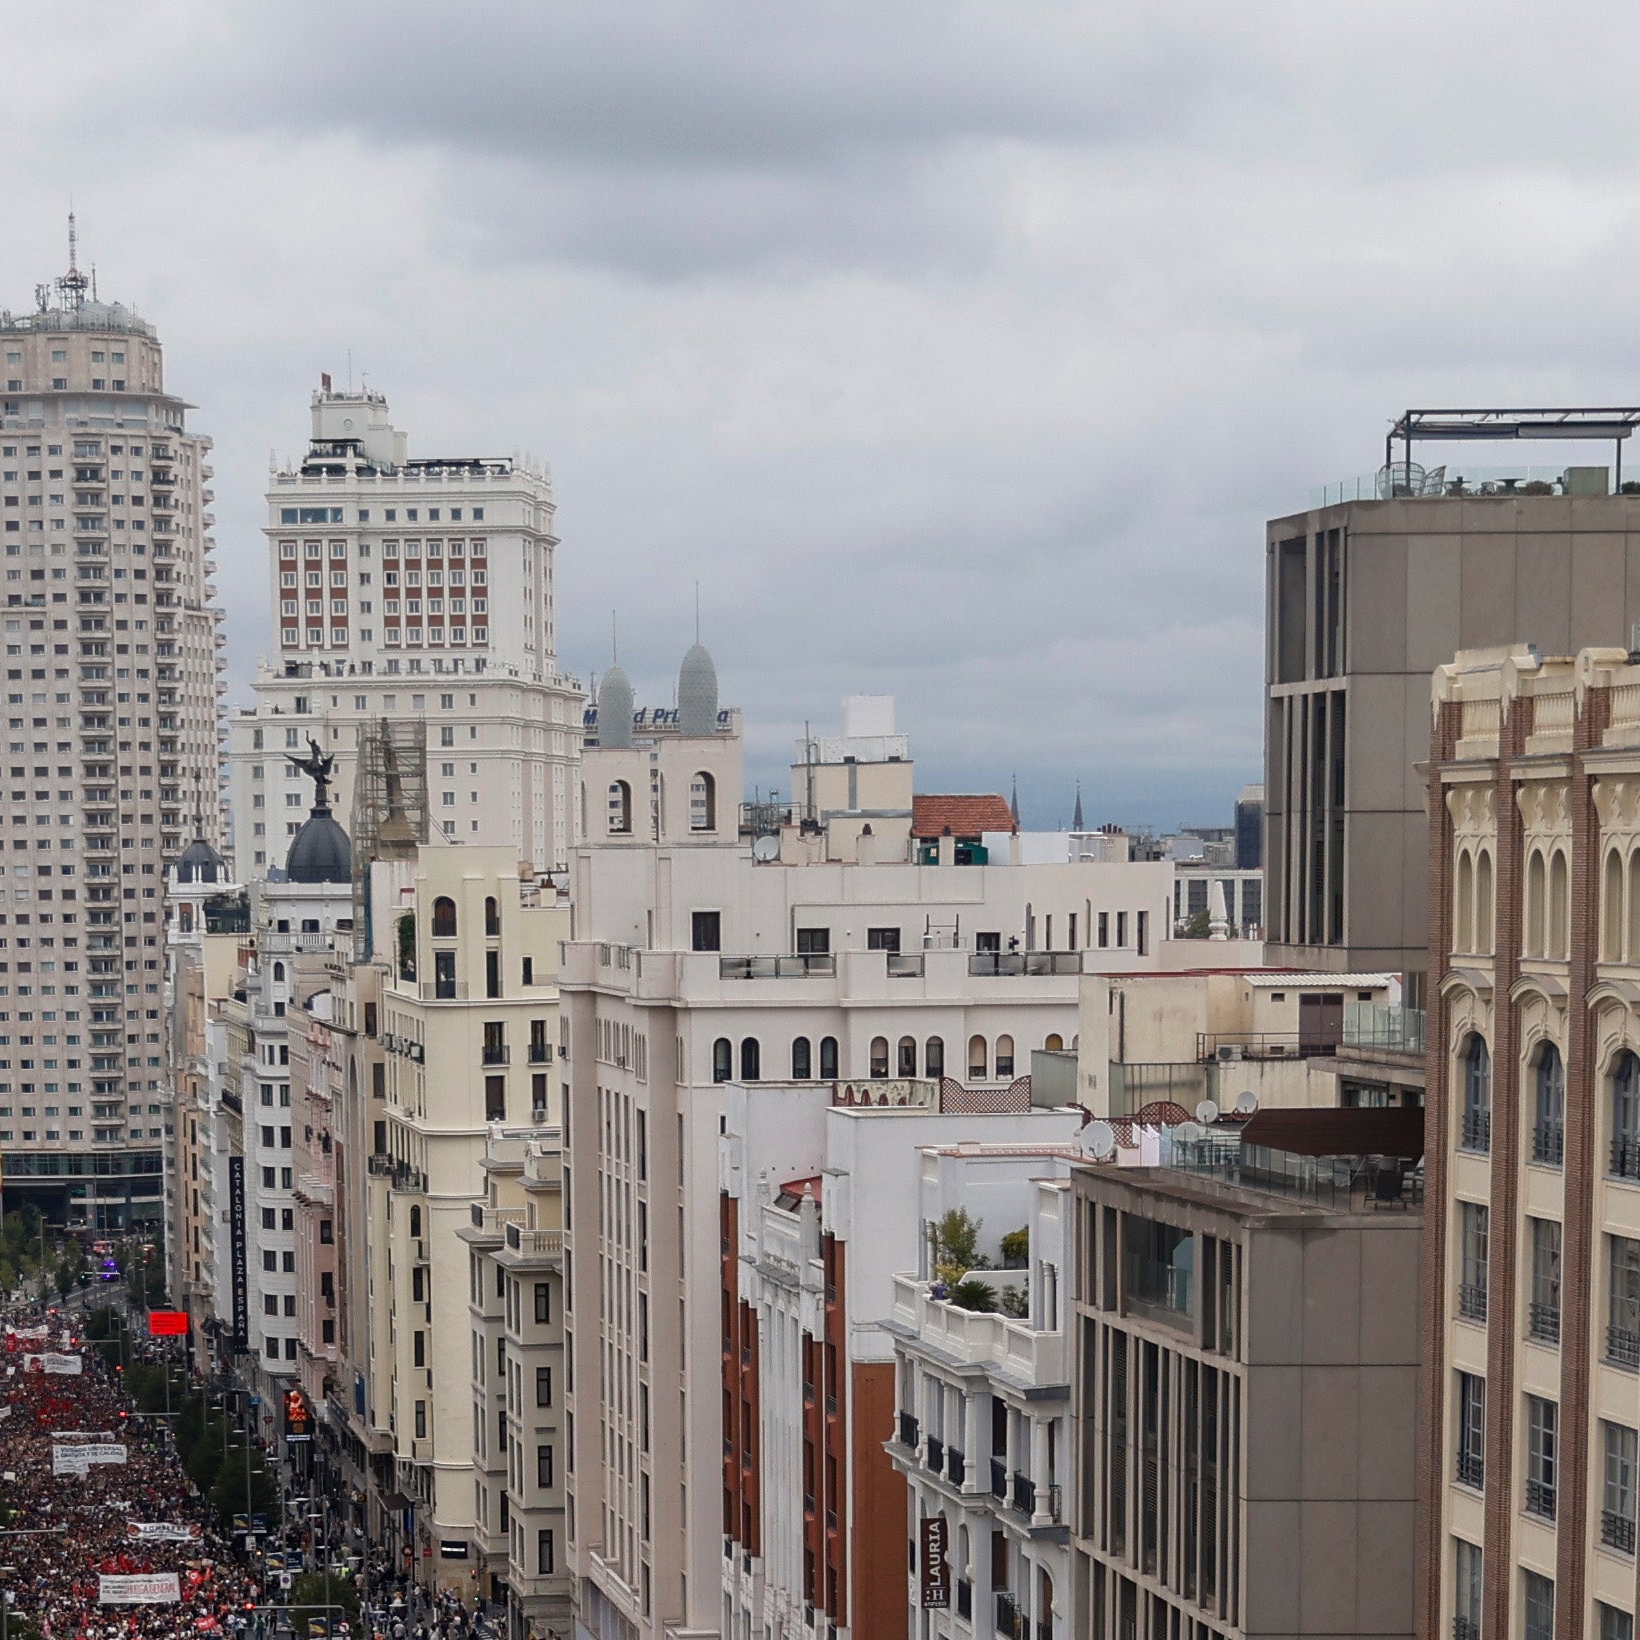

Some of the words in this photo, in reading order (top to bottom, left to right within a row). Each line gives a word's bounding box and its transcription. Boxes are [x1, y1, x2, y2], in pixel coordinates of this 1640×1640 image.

[233, 1163, 243, 1236] CATALONIA
[235, 1241, 244, 1283] PLAZA
[928, 1521, 941, 1587] LAURIA
